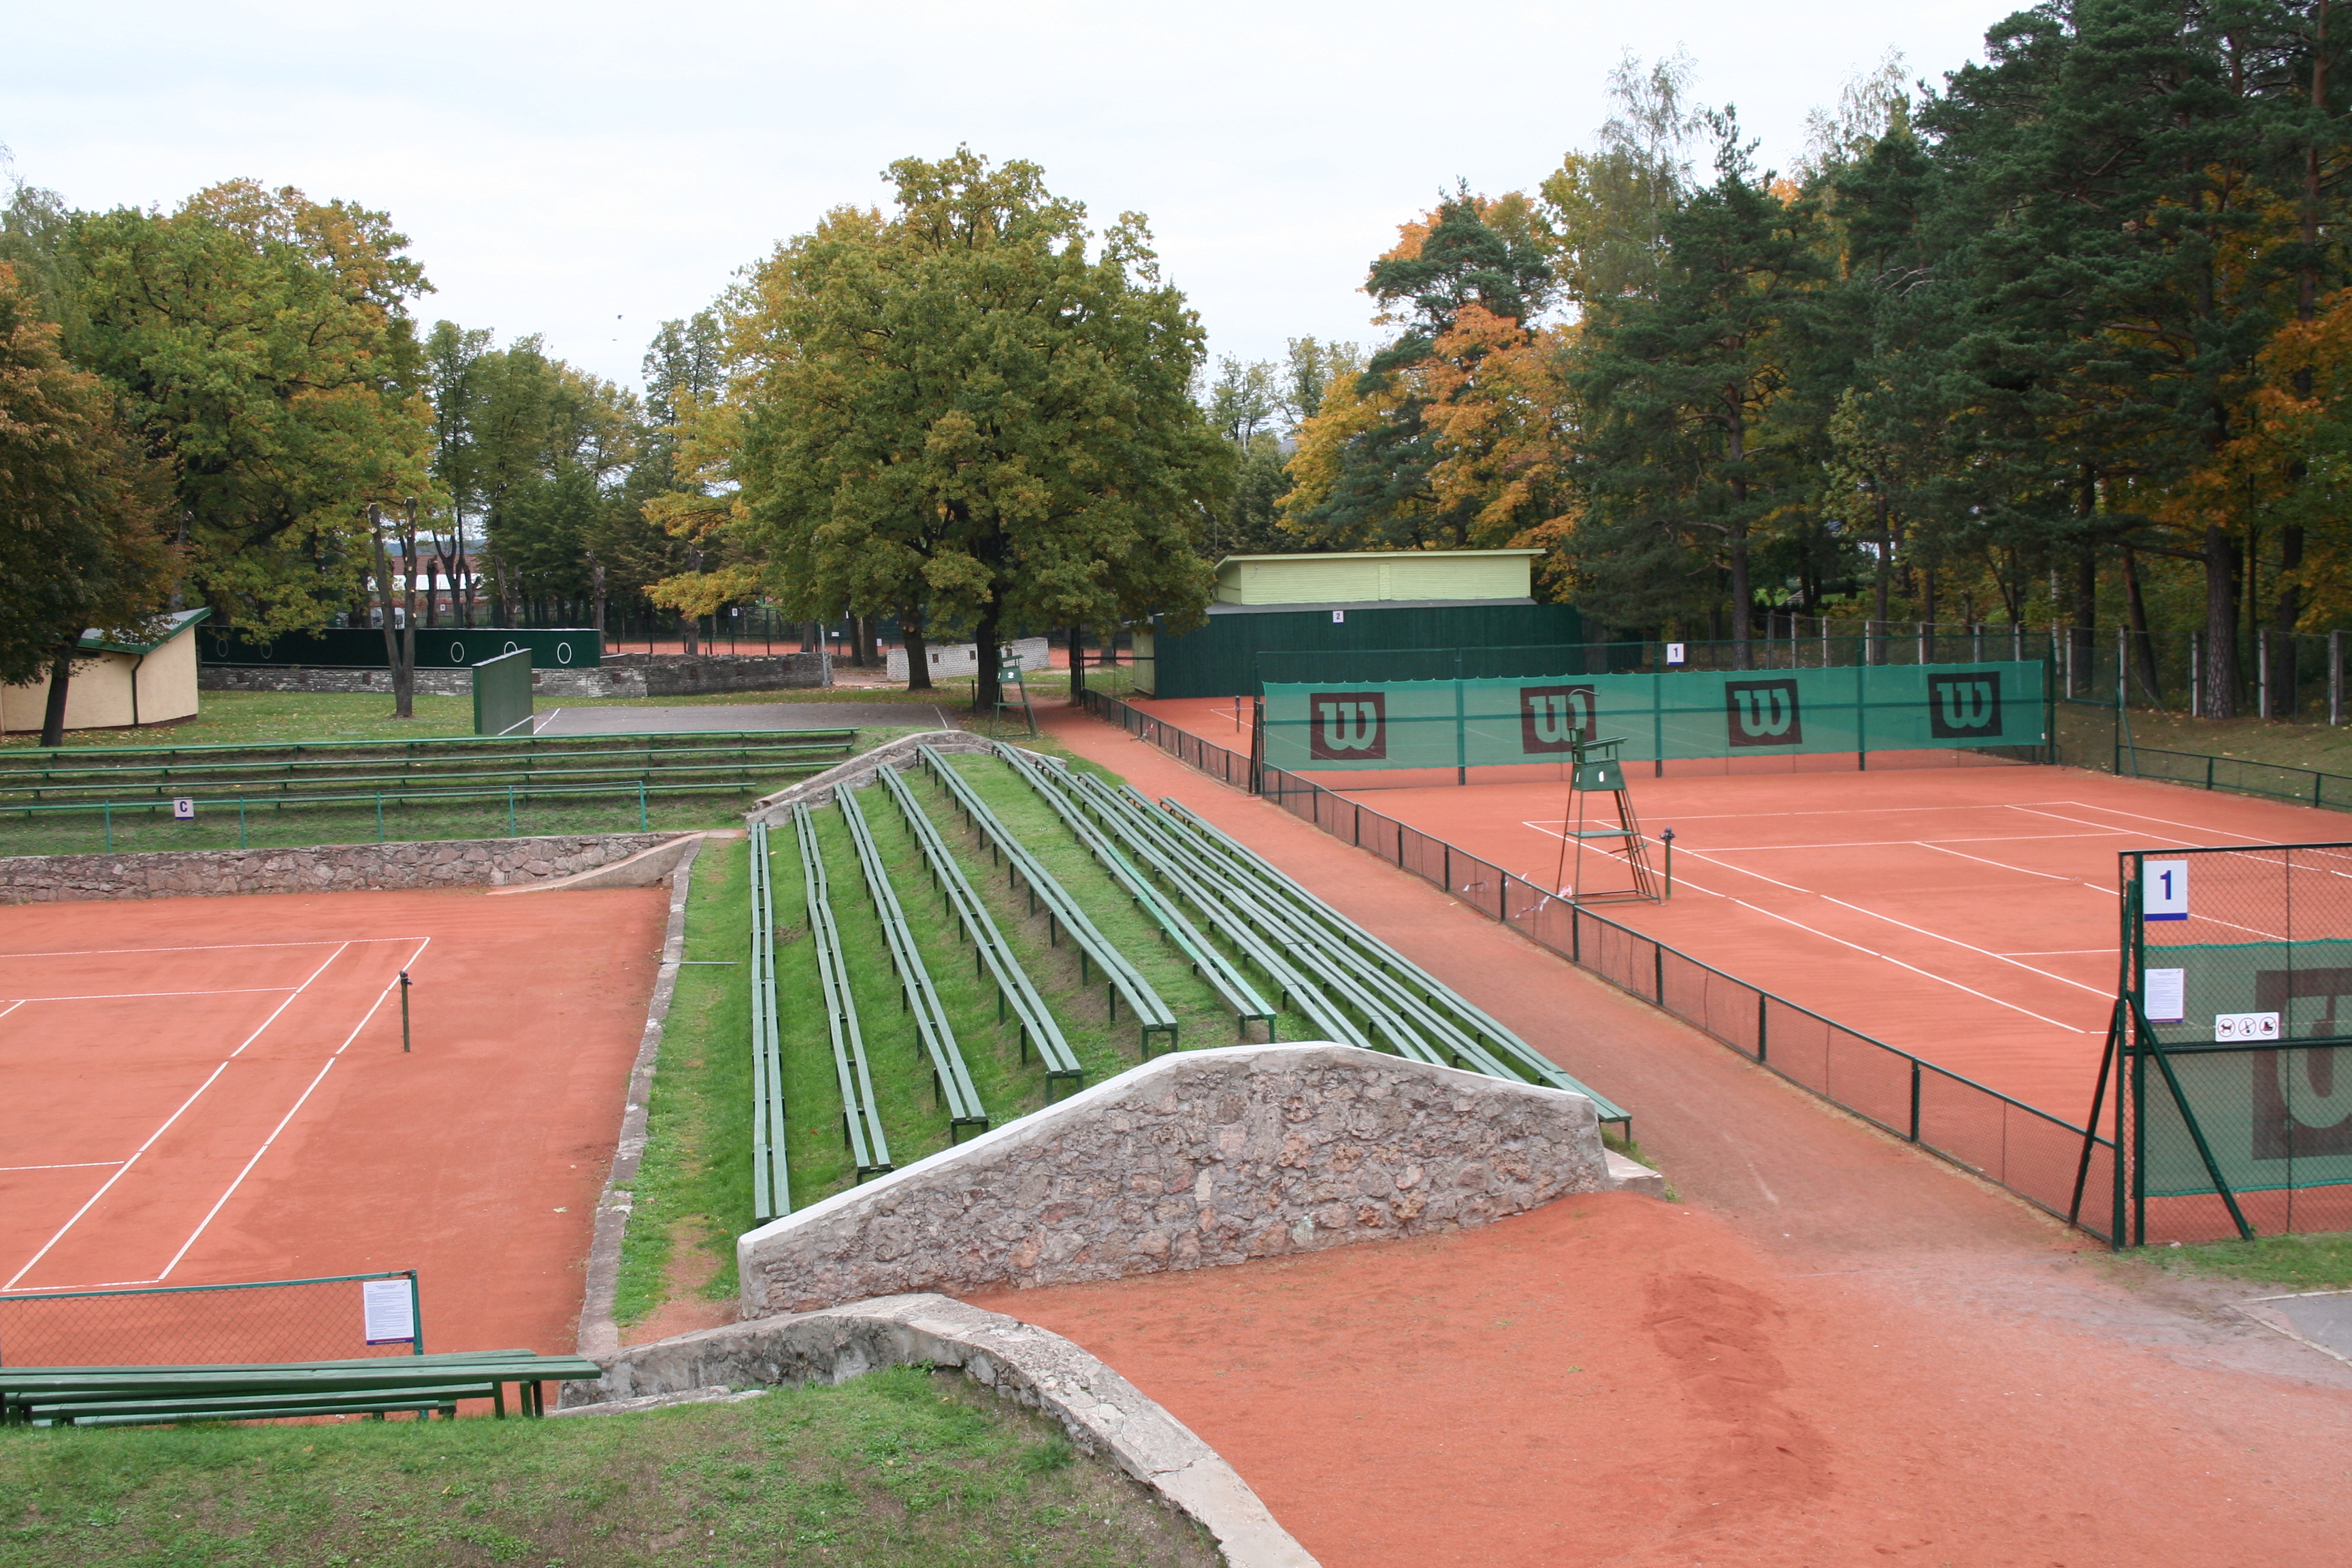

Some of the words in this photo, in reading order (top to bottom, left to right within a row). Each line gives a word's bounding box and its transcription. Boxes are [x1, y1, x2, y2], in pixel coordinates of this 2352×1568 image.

[1673, 647, 1678, 658] 1
[180, 800, 188, 813] C
[2159, 870, 2172, 900] 1
